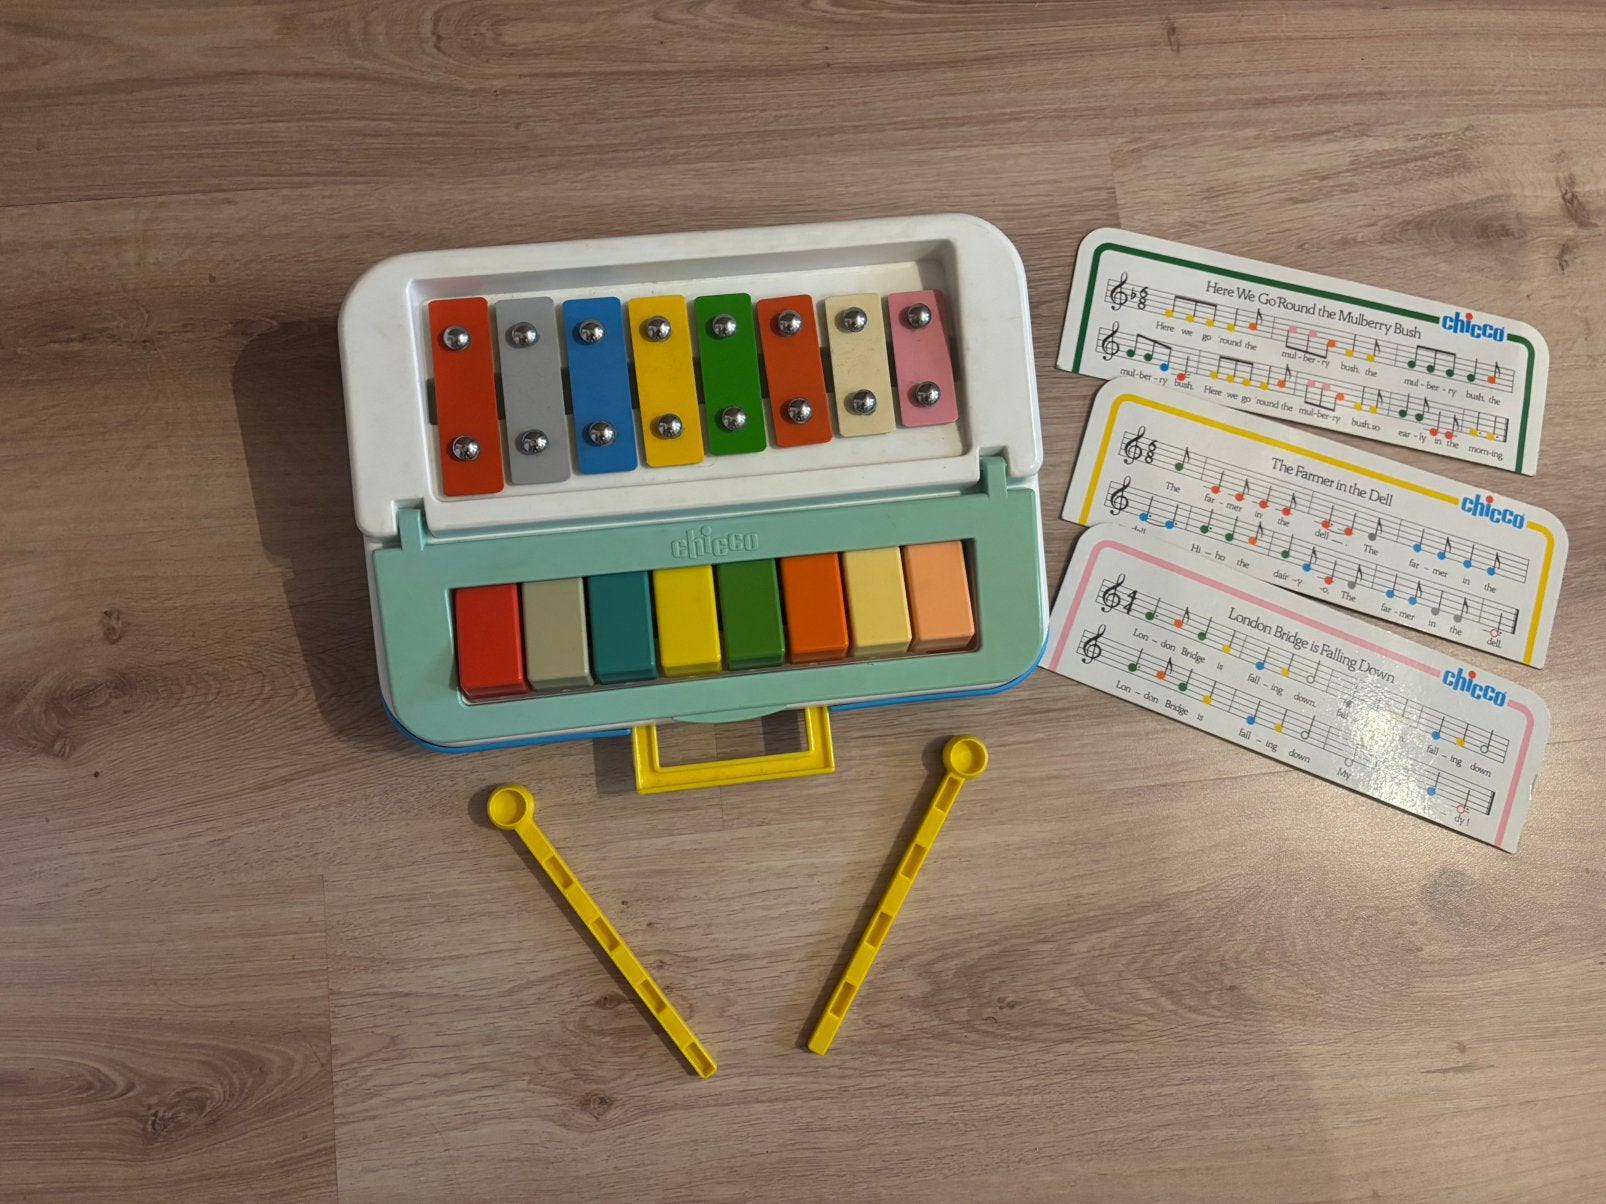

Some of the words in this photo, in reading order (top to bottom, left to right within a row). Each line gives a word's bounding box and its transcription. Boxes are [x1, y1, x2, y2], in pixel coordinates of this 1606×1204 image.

[1205, 280, 1235, 297] Here
[1236, 287, 1256, 302] We
[1258, 292, 1277, 306] Go
[1317, 305, 1337, 319] the
[1338, 309, 1393, 335] Mulberry
[1393, 322, 1421, 340] Bush
[1441, 311, 1505, 342] chicco
[1155, 320, 1175, 333] Here
[1181, 327, 1193, 336] we
[1201, 333, 1212, 342] go
[1244, 341, 1257, 351] the
[1365, 367, 1378, 378] the
[1488, 395, 1501, 406] the
[1203, 385, 1222, 397] Here
[1226, 391, 1239, 400] we
[1240, 395, 1251, 404] go
[1280, 402, 1293, 412] the
[1446, 439, 1459, 449] the
[1271, 457, 1294, 475] The
[1295, 465, 1335, 488] Farmer
[1336, 479, 1348, 492] in
[1348, 483, 1367, 498] the
[1368, 488, 1393, 506] Dell
[1461, 493, 1526, 529] chicco
[670, 525, 759, 559] chicco
[1165, 481, 1180, 493] The
[1254, 510, 1263, 519] in
[1277, 517, 1290, 528] the
[1363, 543, 1379, 556] The
[1462, 576, 1471, 585] in
[1483, 583, 1497, 594] the
[1236, 558, 1250, 569] the
[1341, 590, 1357, 603] The
[1428, 619, 1436, 628] in
[1449, 626, 1462, 636] the
[1227, 607, 1272, 635] London
[1273, 625, 1309, 650] Bridge
[1310, 641, 1320, 653] is
[1319, 643, 1357, 672] Falling
[1358, 658, 1396, 684] Down
[1181, 647, 1206, 664] Bridge
[1216, 662, 1224, 671] is
[1469, 762, 1492, 778] down
[1442, 667, 1507, 707] chicco
[1164, 699, 1189, 716] Bridge
[1196, 712, 1204, 721] is
[1288, 748, 1310, 764] down
